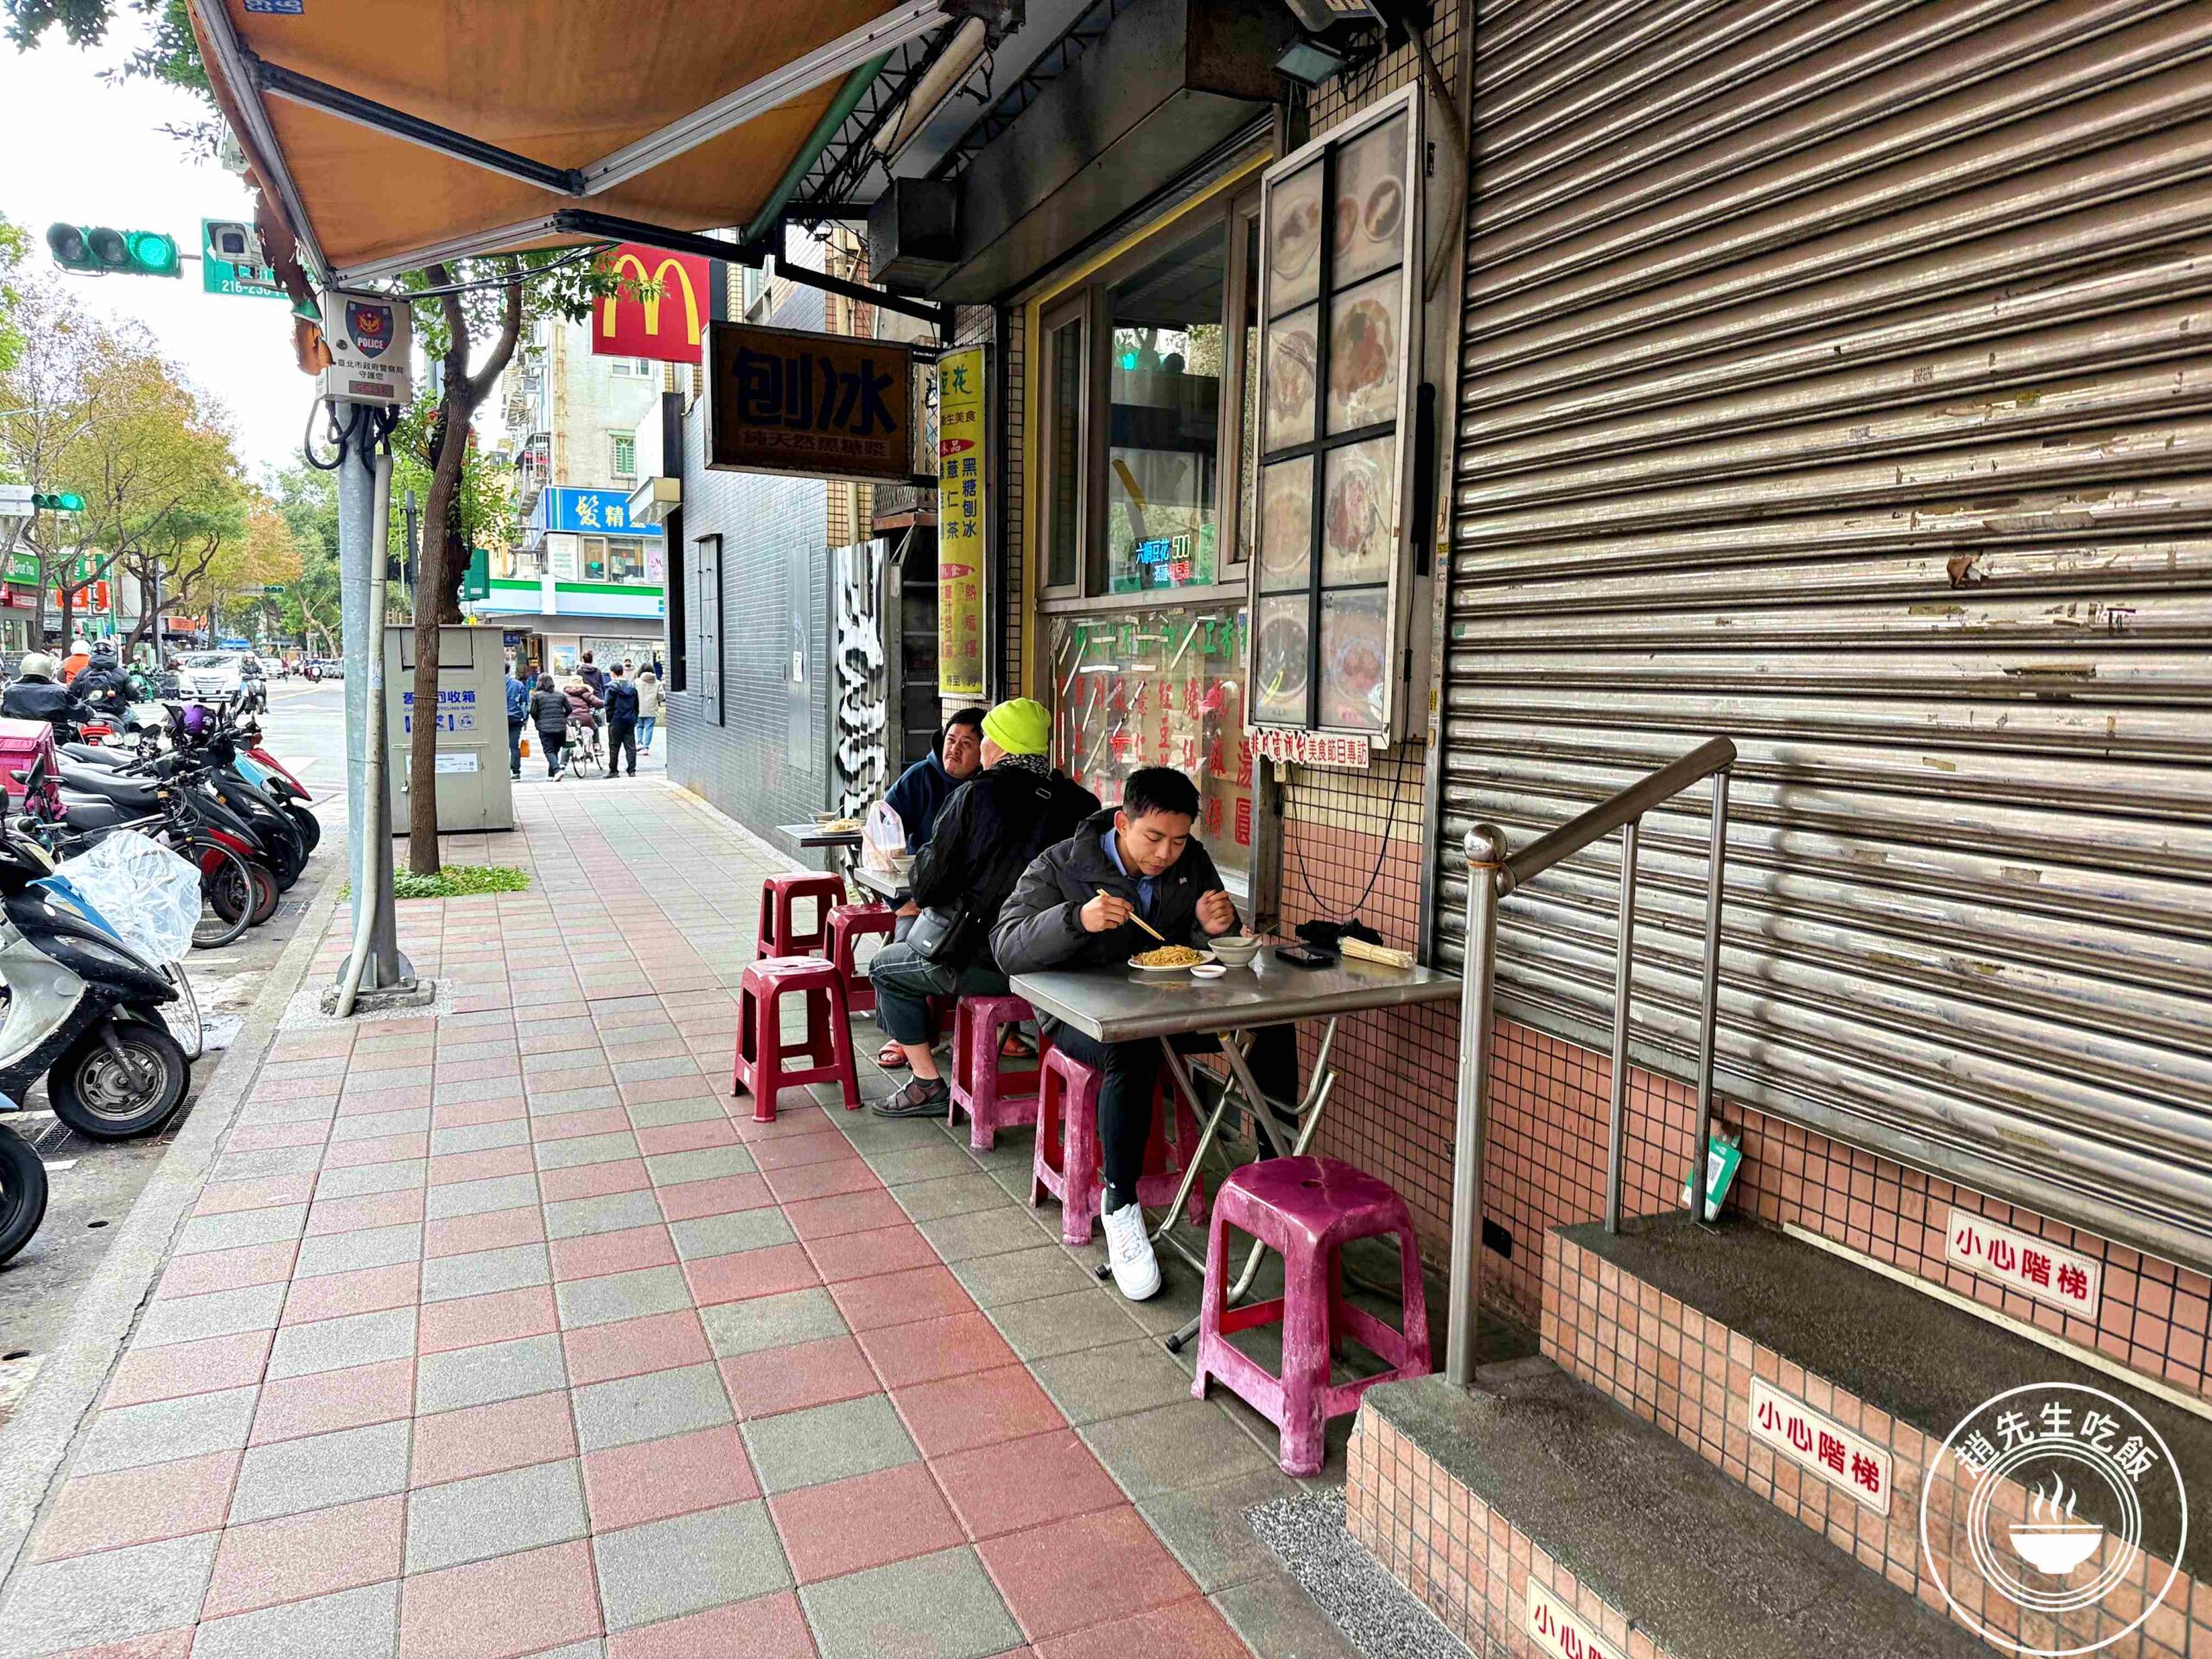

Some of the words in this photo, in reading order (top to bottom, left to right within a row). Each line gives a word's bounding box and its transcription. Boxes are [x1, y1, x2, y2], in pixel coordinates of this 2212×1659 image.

[357, 337, 384, 350] POLICE
[962, 457, 977, 538] 黑糖刨冰
[1955, 1226, 2088, 1301] 小心階梯
[1757, 1400, 1881, 1494] 小心階梯
